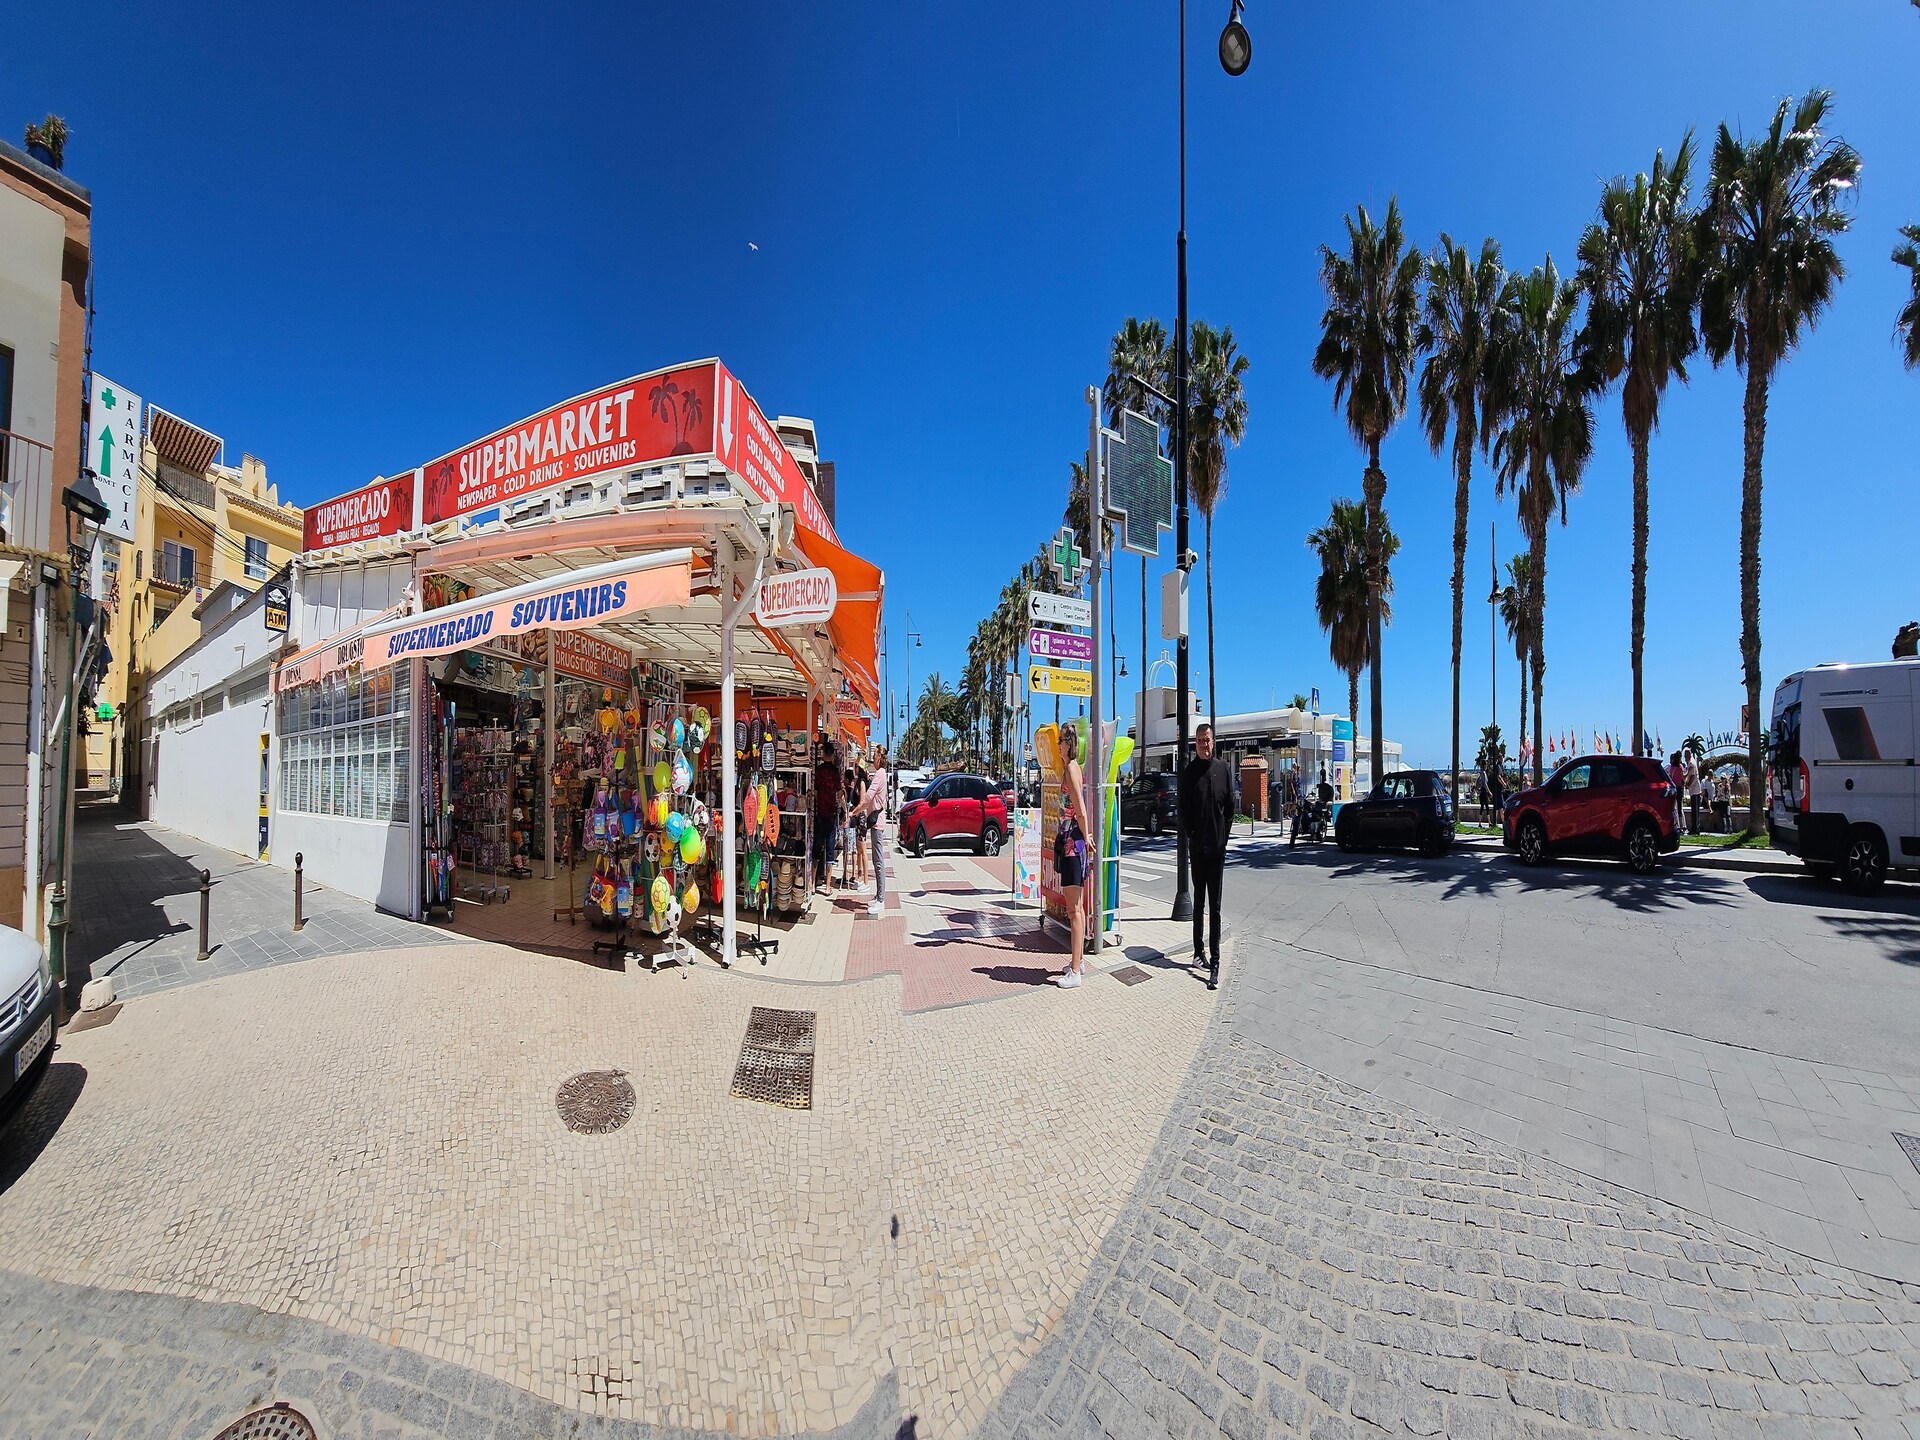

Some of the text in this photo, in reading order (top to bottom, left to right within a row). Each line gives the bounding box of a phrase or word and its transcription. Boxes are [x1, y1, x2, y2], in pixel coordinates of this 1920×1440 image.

[458, 389, 635, 492] SUPERMARKET
[748, 404, 783, 467] NEWSPAPER
[120, 399, 136, 531] FARMACIA
[457, 439, 637, 511] NEWSPAPER COLD DRINKS SOUVENIRS
[746, 433, 785, 493] COLD DRINKS
[316, 486, 391, 535] SUPERMERCADO
[267, 611, 287, 626] ATM
[387, 581, 627, 659] SUPERMERCADO SOUVENIRS
[760, 576, 830, 613] SUPERMERCADO
[554, 630, 629, 670] SUPERMERCADO
[555, 651, 598, 676] DRUGSTORE
[1235, 739, 1258, 747] ANTONIO
